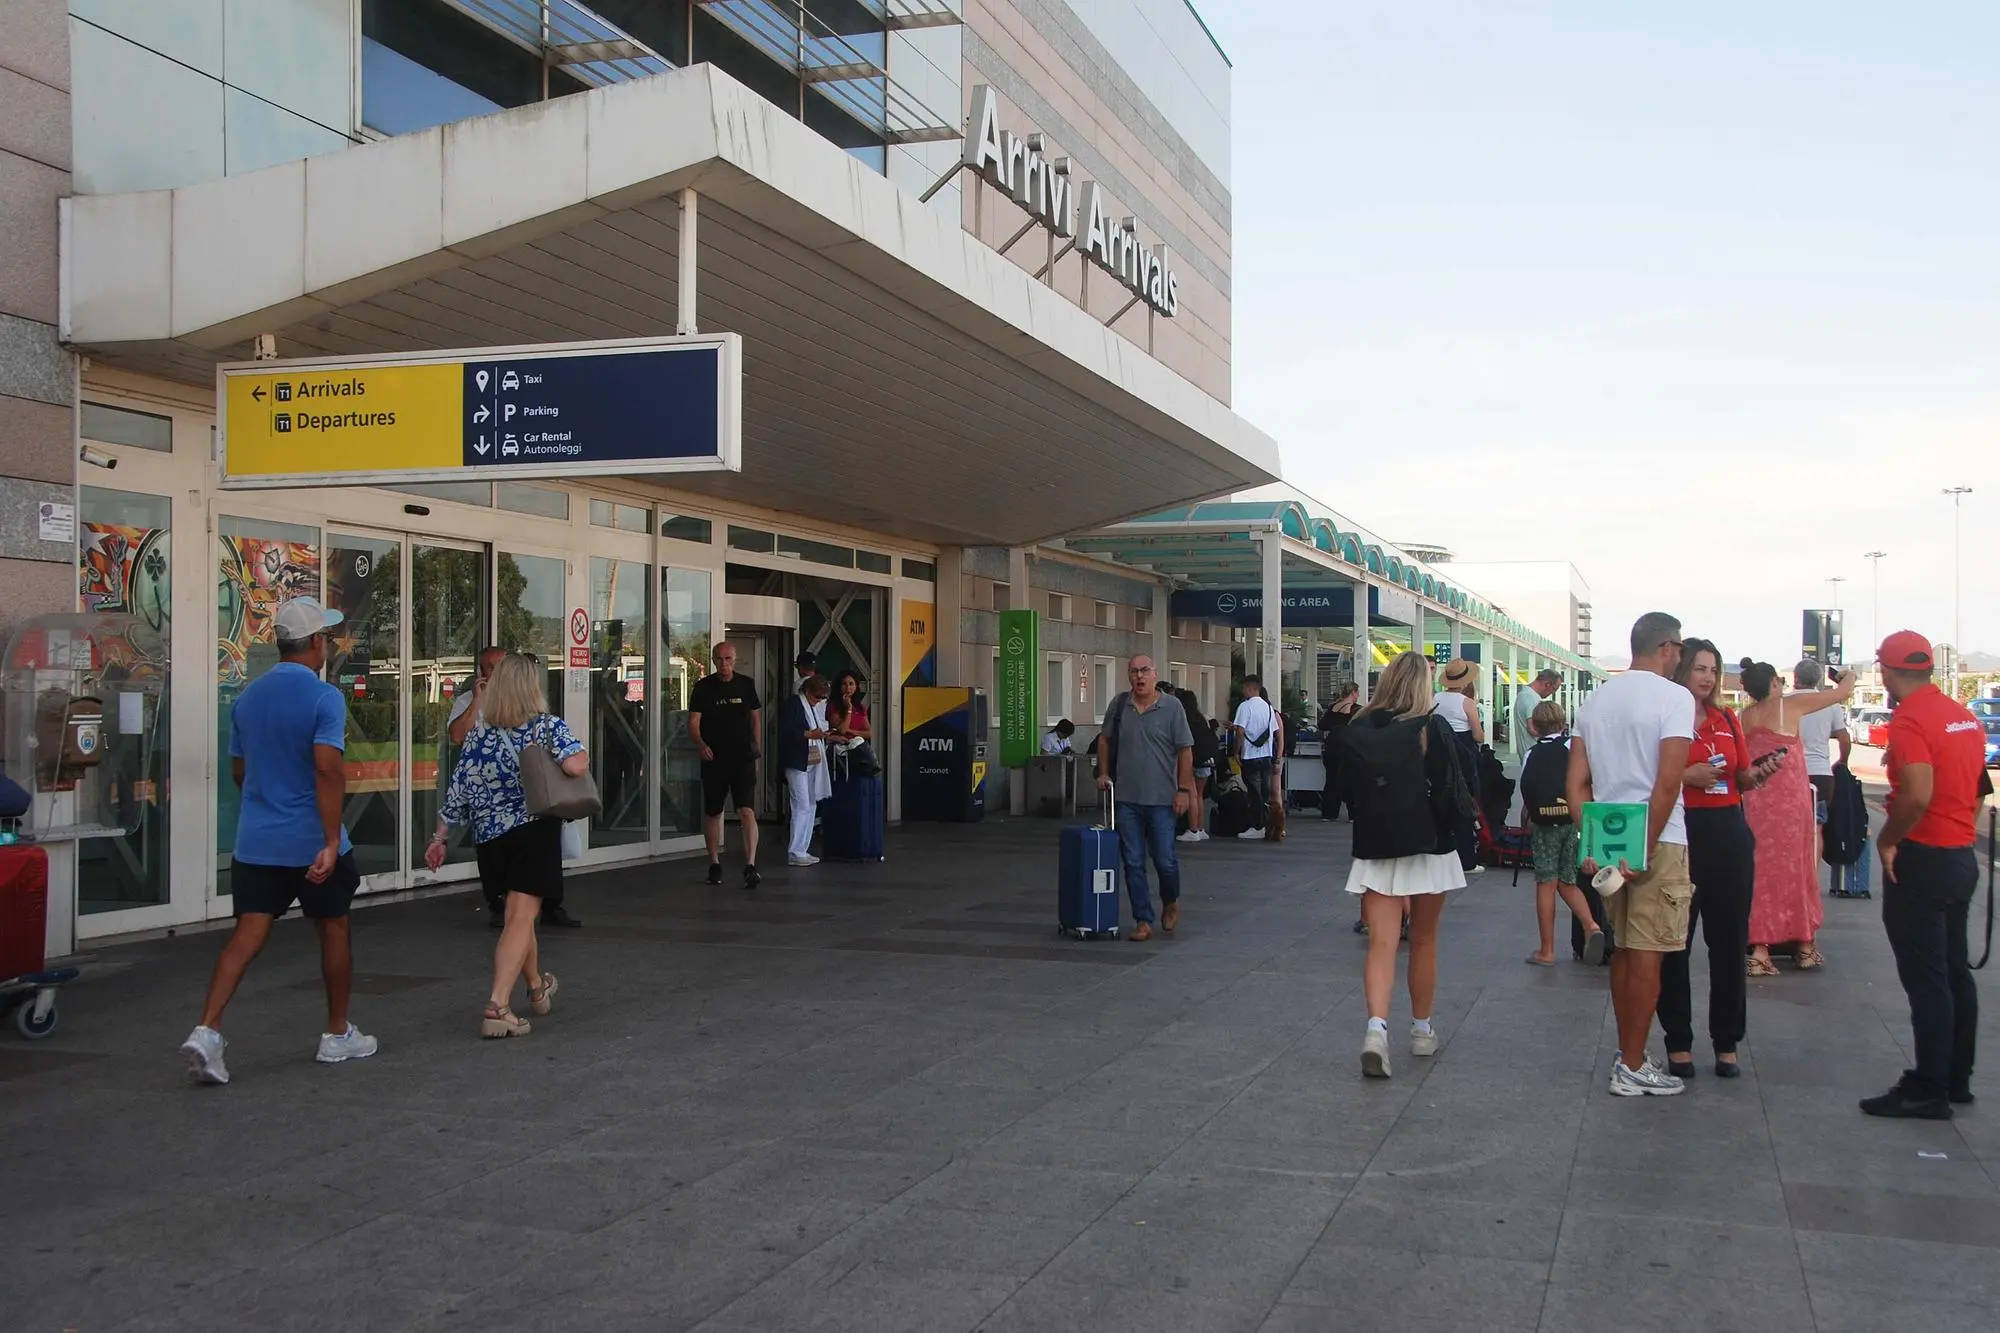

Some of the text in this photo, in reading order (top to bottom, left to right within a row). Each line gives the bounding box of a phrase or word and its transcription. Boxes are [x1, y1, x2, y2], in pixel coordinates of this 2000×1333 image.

[964, 85, 1178, 318] Arrivi Arrivals
[523, 374, 542, 384] Taxi
[280, 378, 365, 399] T1 Arrivals
[504, 404, 559, 422] P Parking
[279, 411, 396, 432] T1 Departures
[523, 431, 572, 443] Car Rental
[523, 443, 582, 455] Autonoleggi
[1299, 597, 1330, 607] AREA
[909, 619, 925, 635] ATM
[1007, 660, 1016, 677] QUI
[1018, 728, 1025, 741] DO
[919, 738, 953, 751] ATM
[1602, 812, 1628, 860] 10
